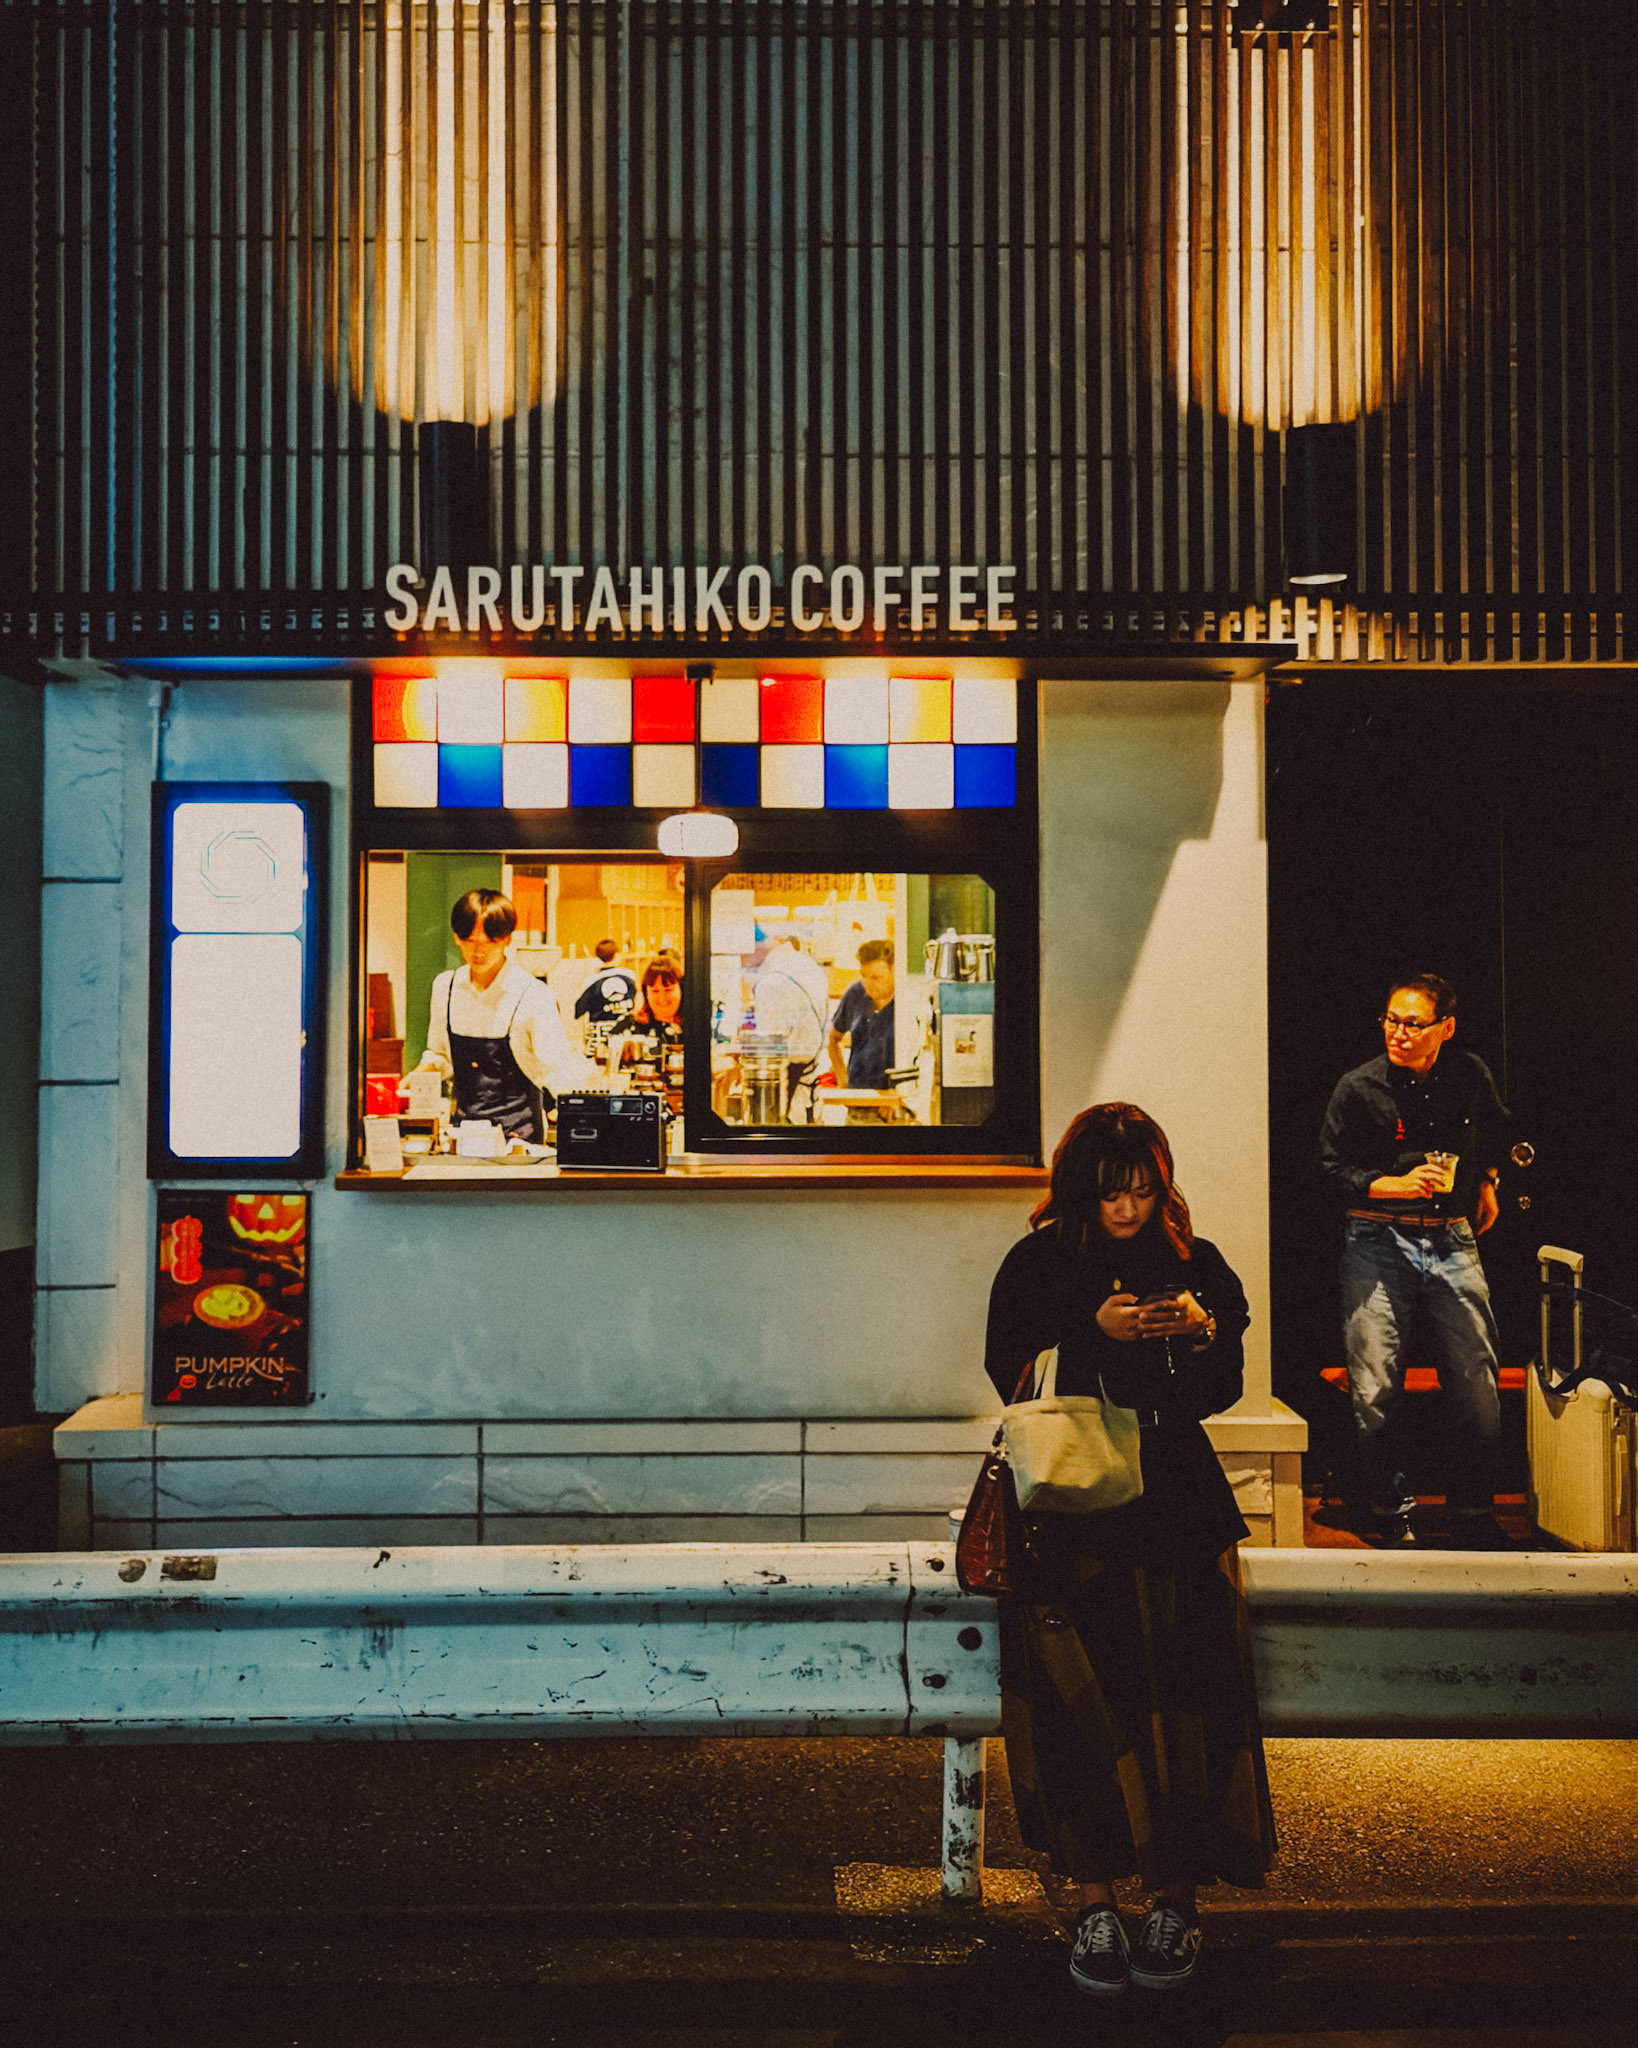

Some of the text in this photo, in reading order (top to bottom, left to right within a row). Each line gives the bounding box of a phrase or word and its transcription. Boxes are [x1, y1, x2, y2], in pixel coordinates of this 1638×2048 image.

[384, 564, 1018, 633] SARUTAHIKO COFFEE
[175, 1356, 284, 1381] PUMPKIN
